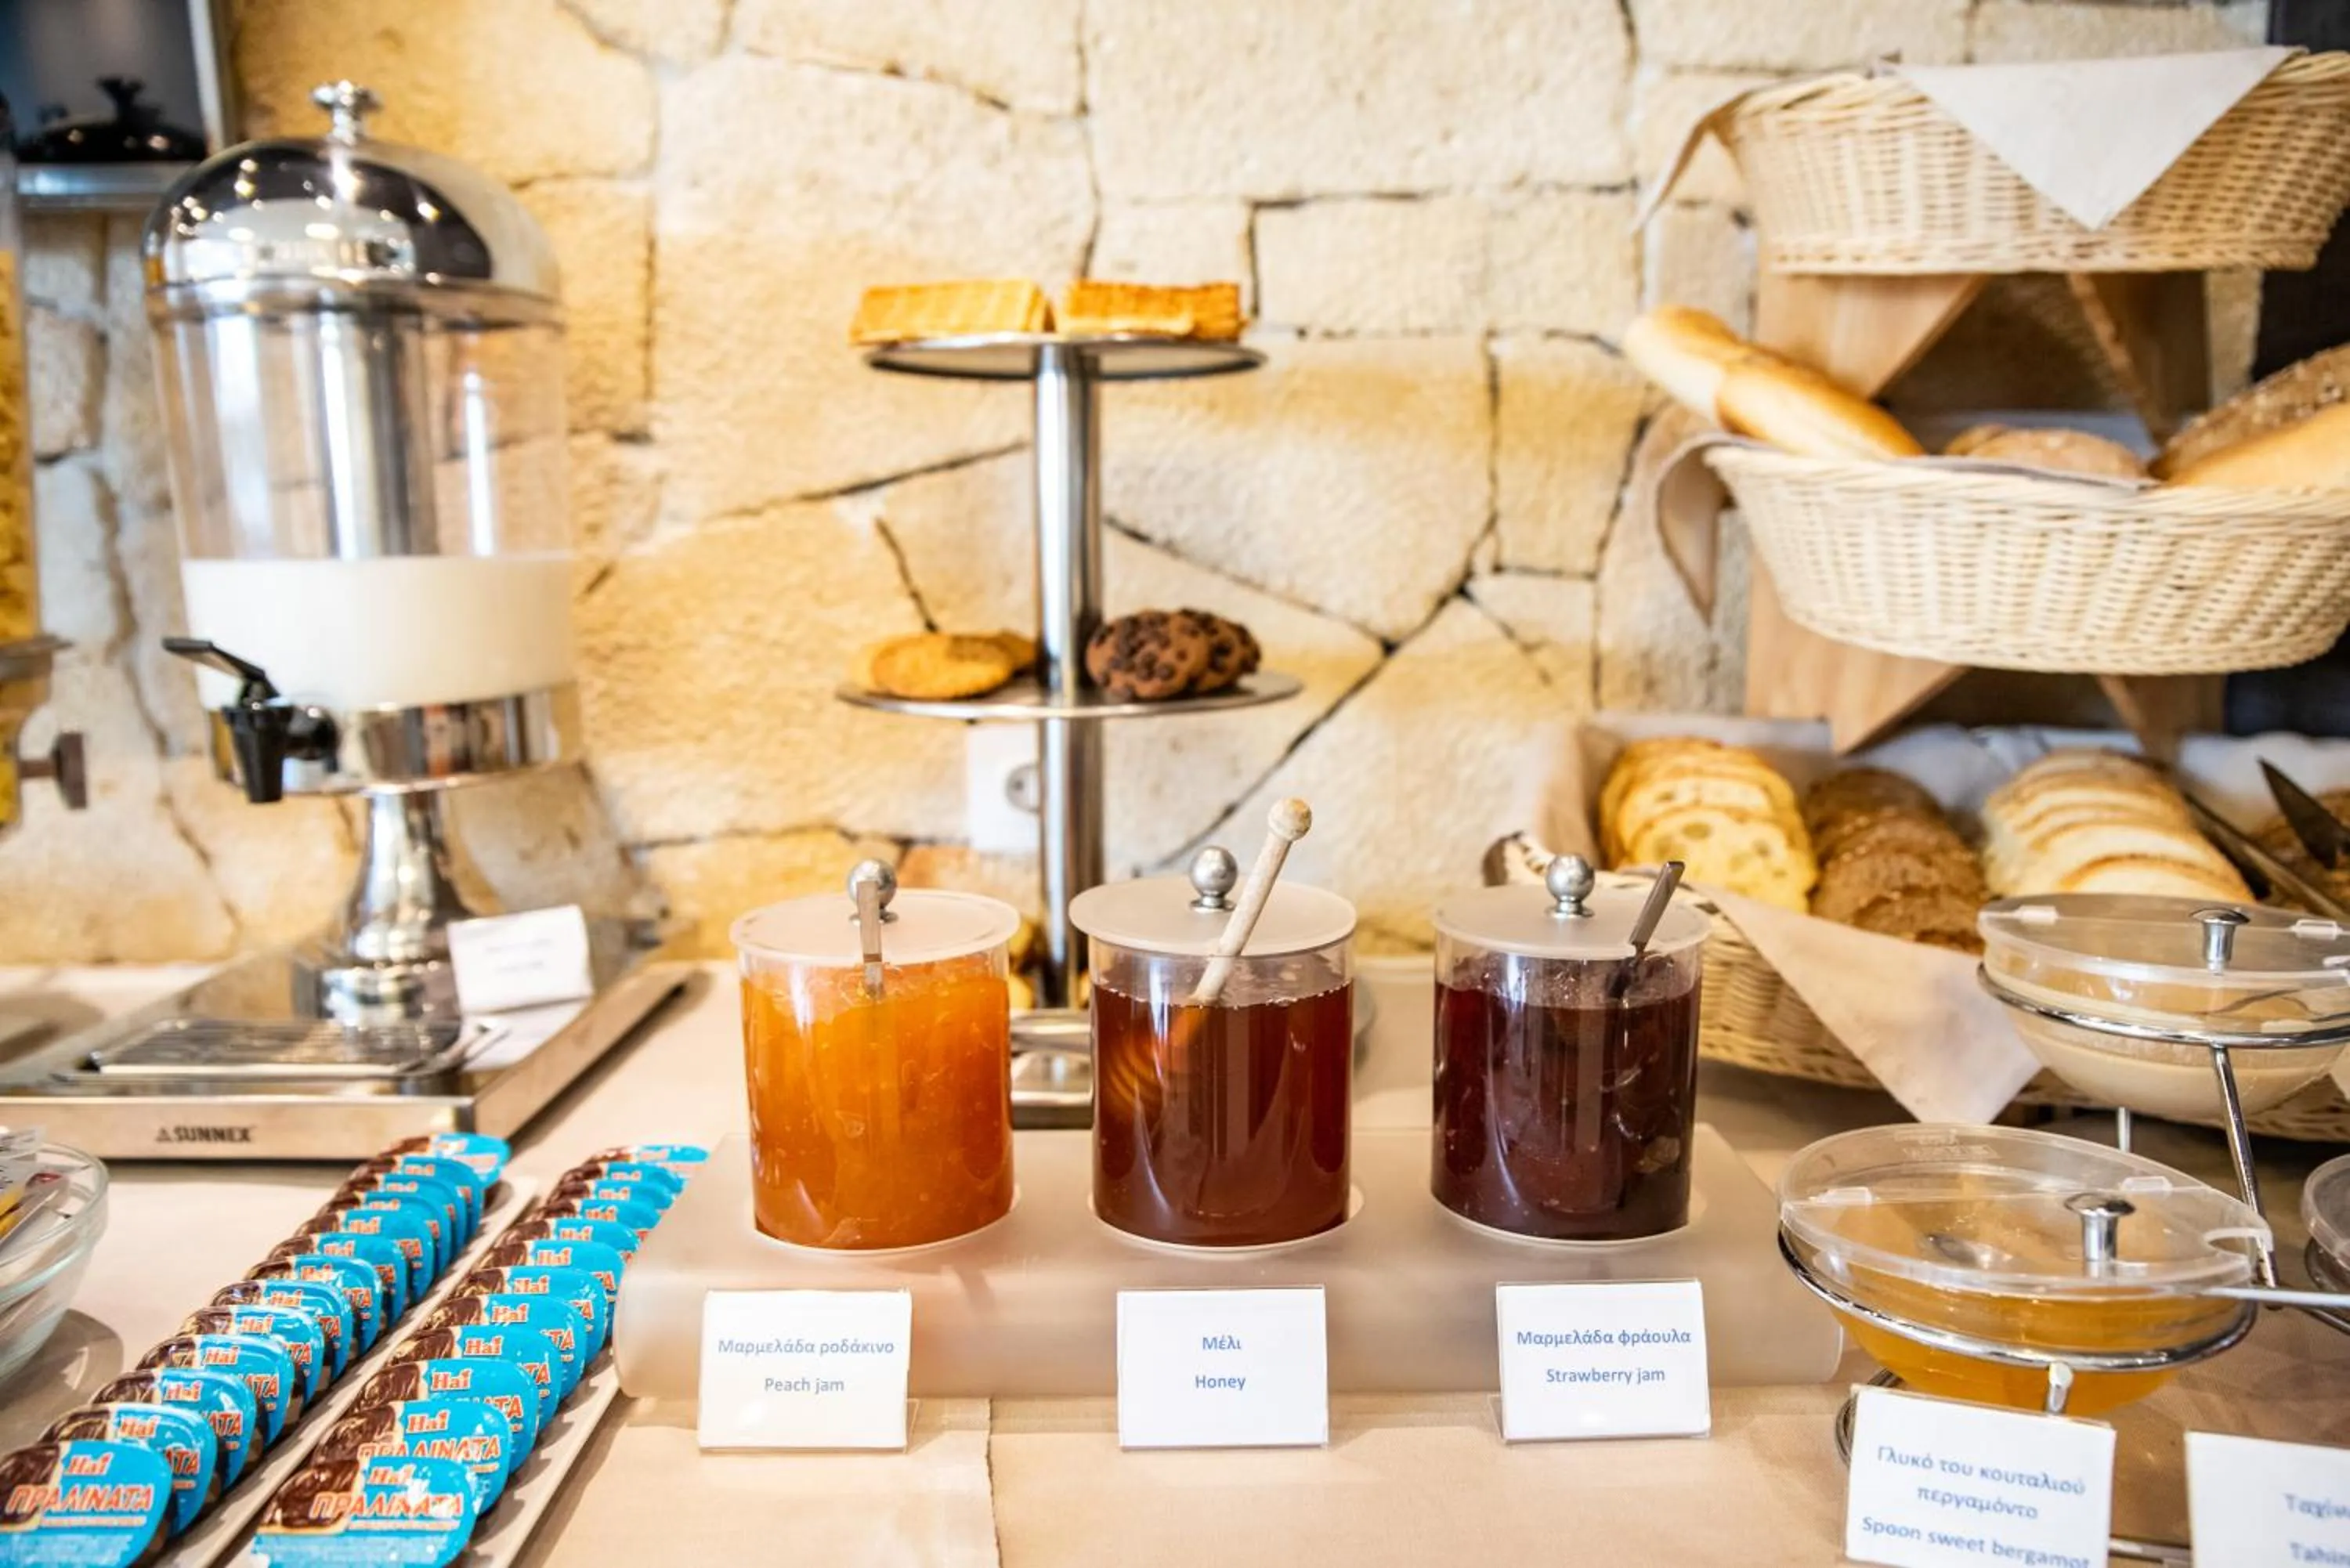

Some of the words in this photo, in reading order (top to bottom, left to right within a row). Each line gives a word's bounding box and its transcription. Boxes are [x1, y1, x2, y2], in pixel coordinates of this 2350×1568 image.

[1202, 1335, 1242, 1351] Μέλι
[1517, 1329, 1614, 1347] Μαρμελάδα
[1618, 1328, 1691, 1347] φράουλα
[718, 1339, 815, 1357] Μαρμελάδα
[819, 1339, 895, 1357] ροδάκινο
[1195, 1375, 1246, 1391] Honey
[1546, 1367, 1632, 1385] Strawberry
[1636, 1367, 1665, 1385] jam
[764, 1377, 811, 1393] Peach
[815, 1377, 844, 1395] jam
[1878, 1445, 1934, 1470] Γλυκό
[1940, 1459, 1973, 1477] του
[1979, 1465, 2086, 1496] κουταλιού
[1862, 1516, 1922, 1541] Spoon
[1928, 1530, 1986, 1554] sweet
[1991, 1539, 2091, 1568] bergamot
